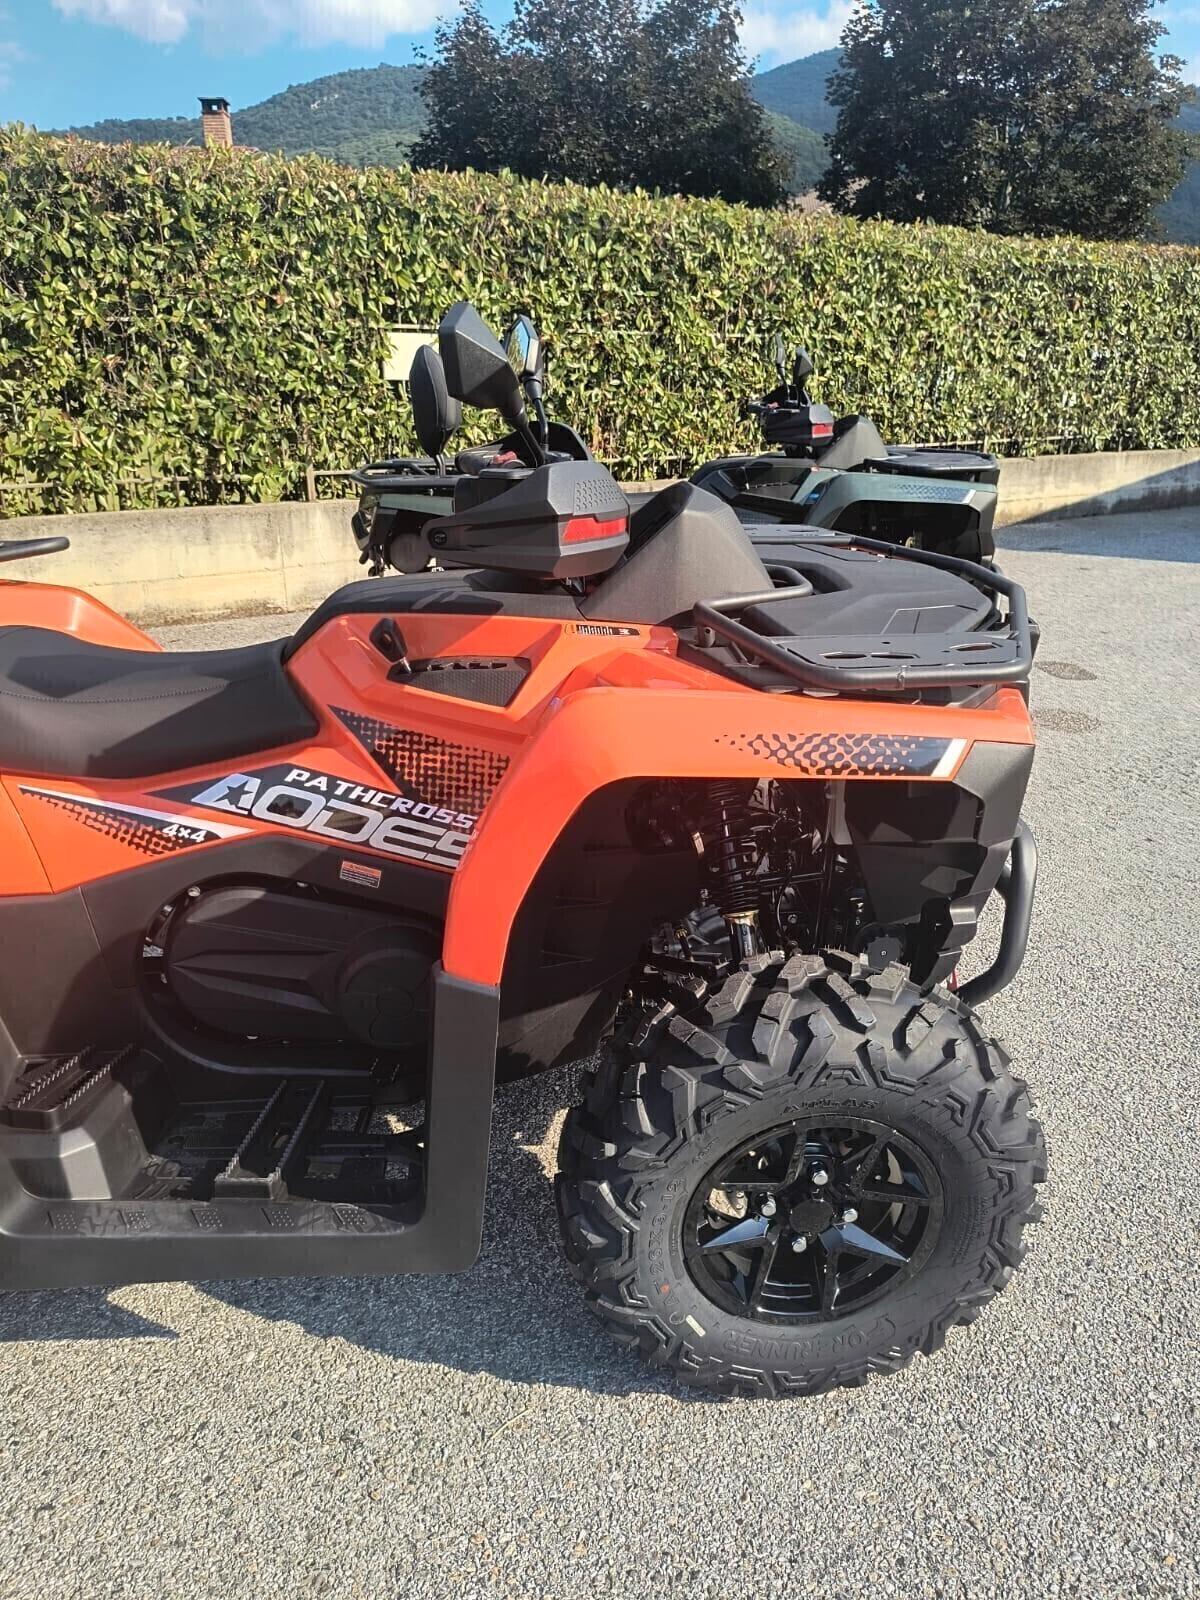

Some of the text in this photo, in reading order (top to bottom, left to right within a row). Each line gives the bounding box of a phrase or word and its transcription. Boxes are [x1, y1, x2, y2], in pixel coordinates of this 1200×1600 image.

[190, 773, 472, 867] AODES
[284, 768, 478, 829] PATHCROSS
[161, 823, 208, 843] 4x4
